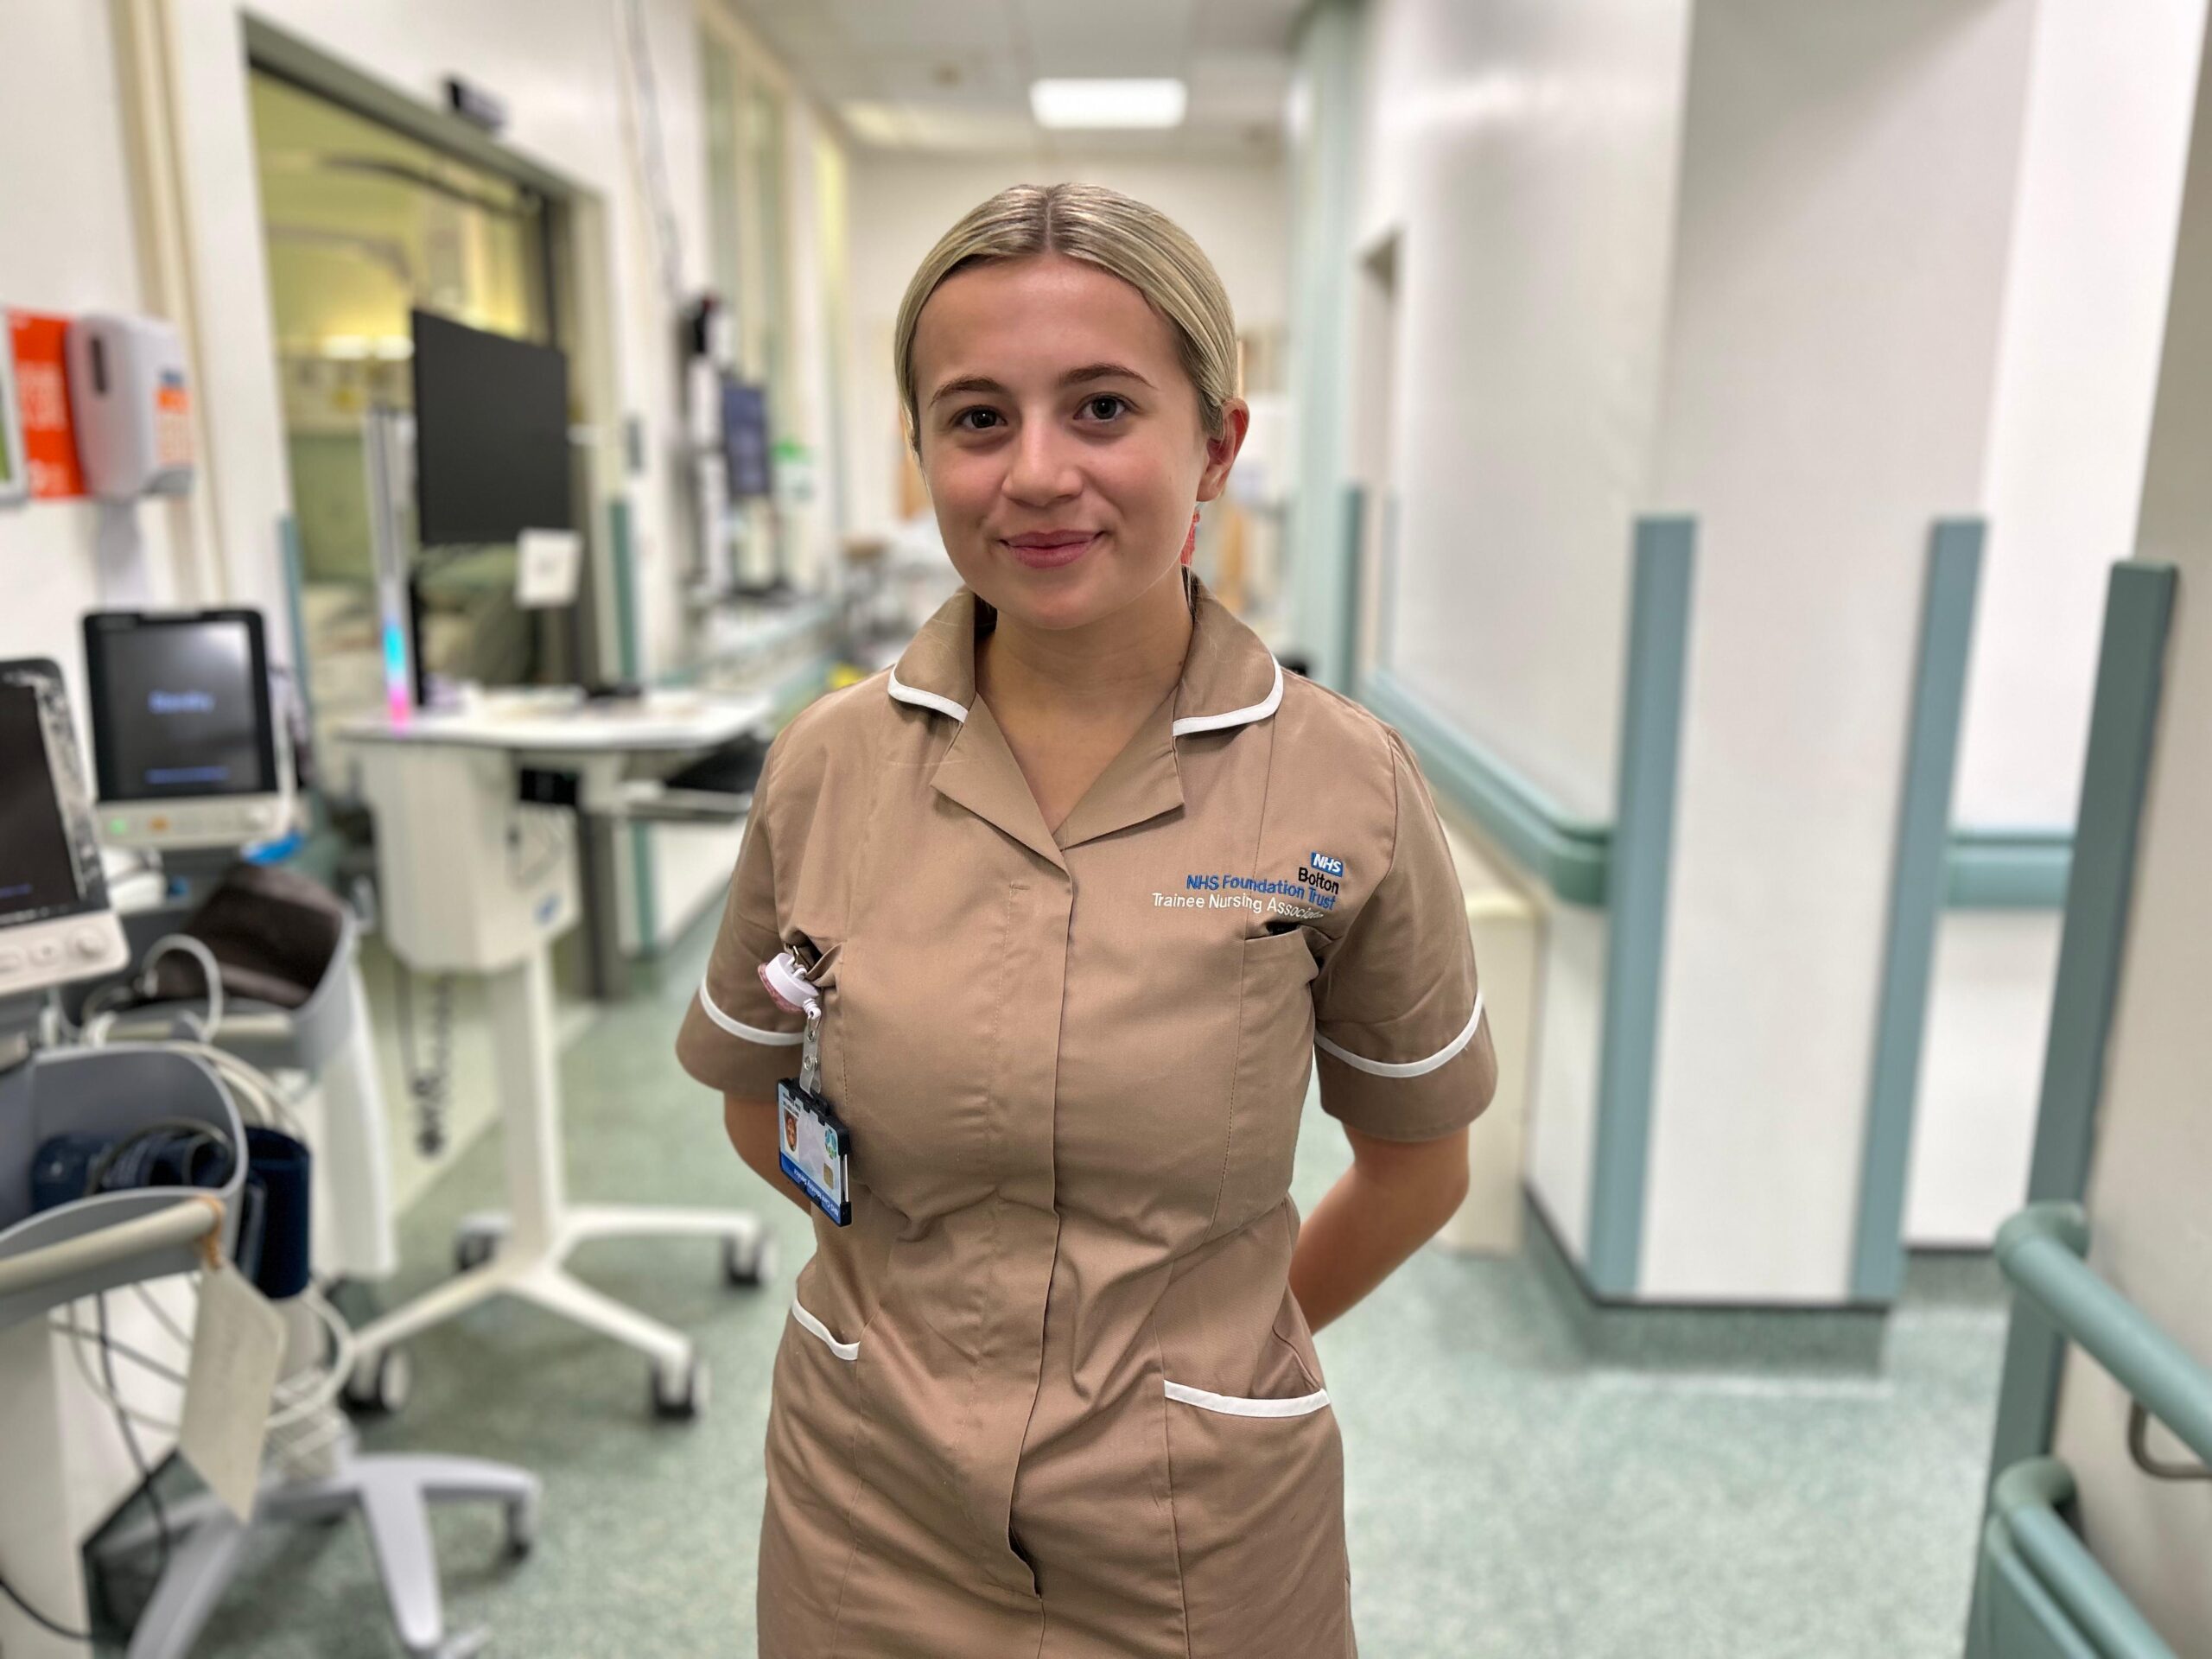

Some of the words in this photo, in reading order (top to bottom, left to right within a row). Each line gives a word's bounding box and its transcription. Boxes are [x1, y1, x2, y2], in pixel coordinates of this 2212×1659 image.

[1313, 853, 1342, 873] NHS
[1186, 874, 1219, 891] NHS
[1223, 874, 1304, 899] Foundation
[1308, 887, 1336, 911] Trust
[1298, 867, 1339, 894] Bolton
[1152, 892, 1205, 907] Trainee
[1209, 893, 1262, 913] Nursing
